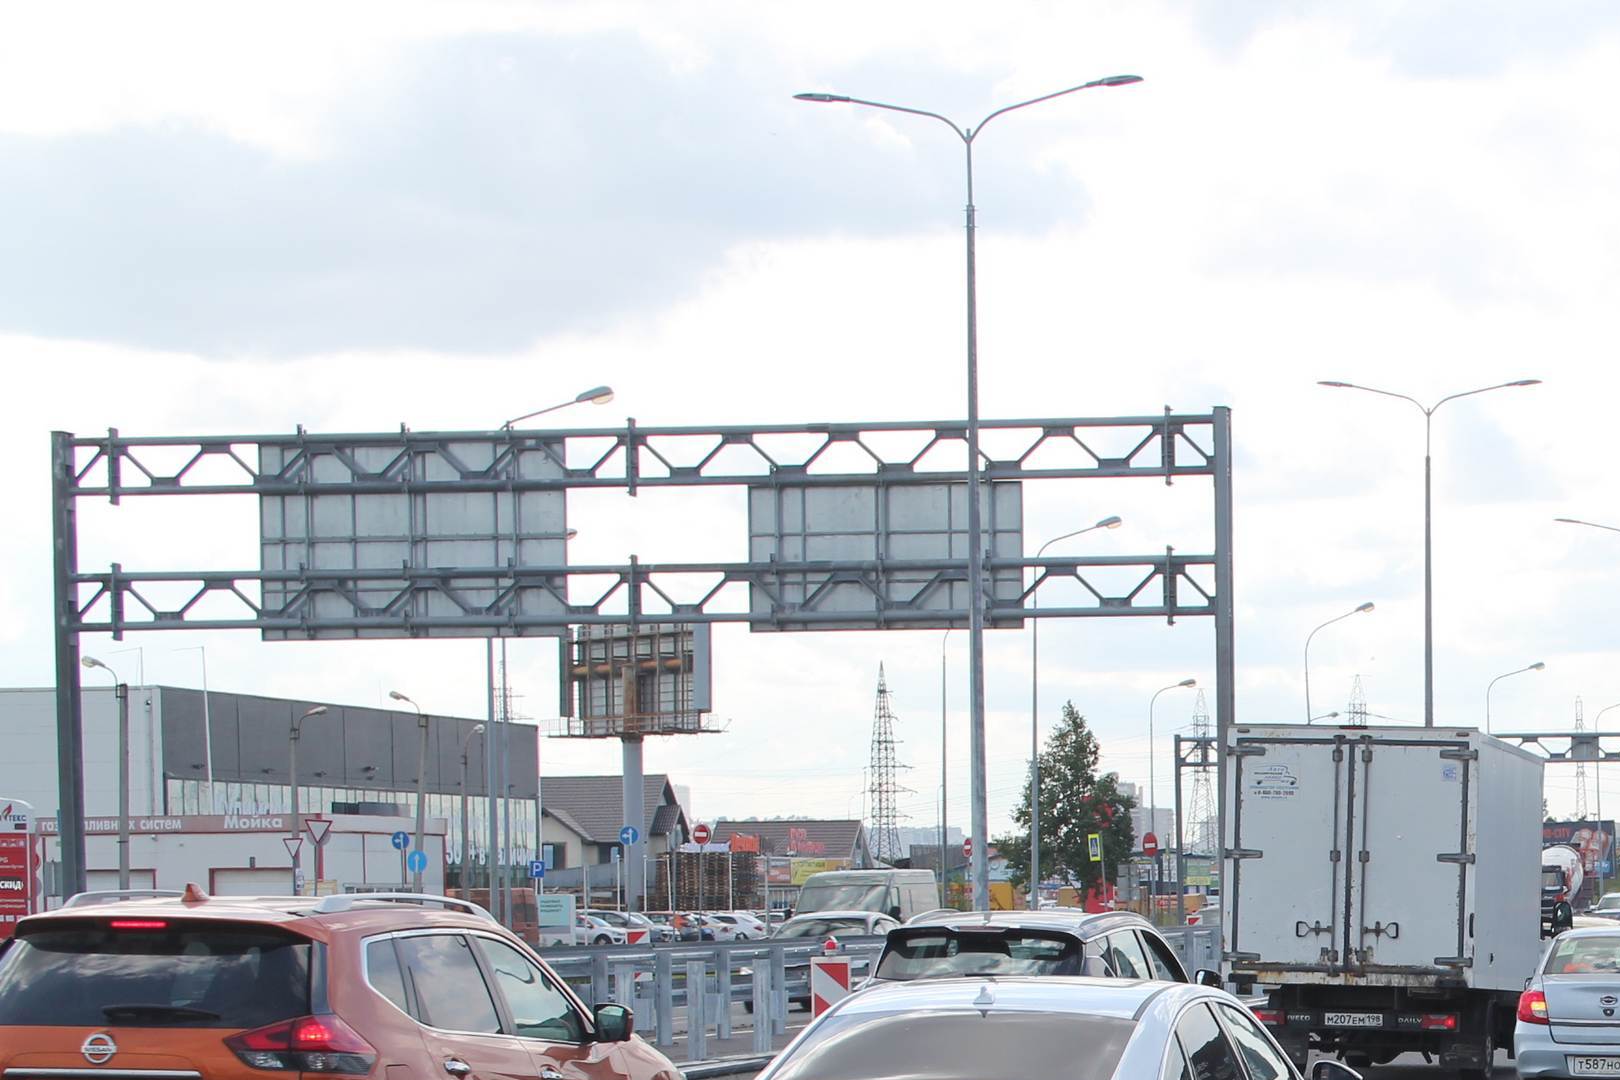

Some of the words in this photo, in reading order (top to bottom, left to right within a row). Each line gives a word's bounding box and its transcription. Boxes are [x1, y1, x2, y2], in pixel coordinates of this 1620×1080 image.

[140, 820, 182, 831] систем
[224, 812, 283, 829] Мойка
[1326, 1014, 1365, 1025] М207ЕМ
[1578, 1058, 1620, 1070] Т587НО
